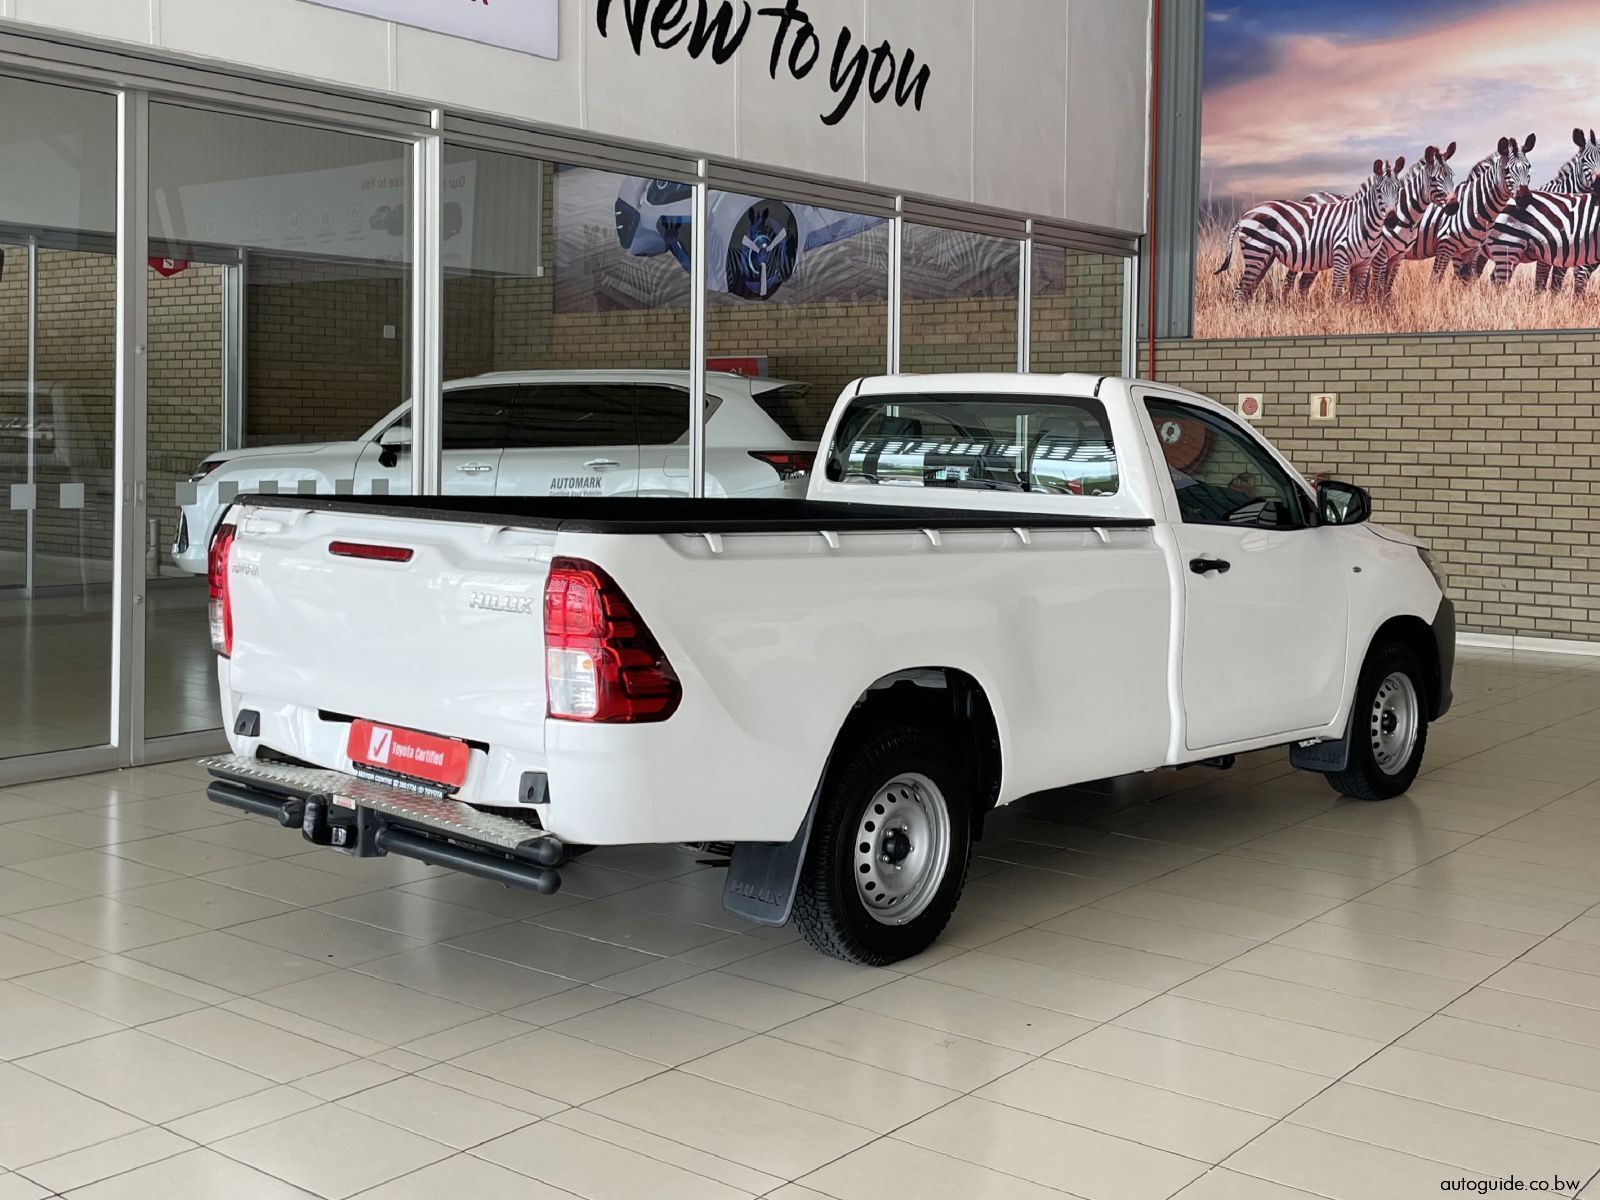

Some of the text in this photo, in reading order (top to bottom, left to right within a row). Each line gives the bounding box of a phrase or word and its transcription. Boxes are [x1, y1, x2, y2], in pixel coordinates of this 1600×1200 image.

[597, 0, 931, 125] New to you
[550, 476, 602, 489] AUTOMARK
[469, 592, 533, 613] HILUX
[392, 742, 444, 766] Toyota Certified
